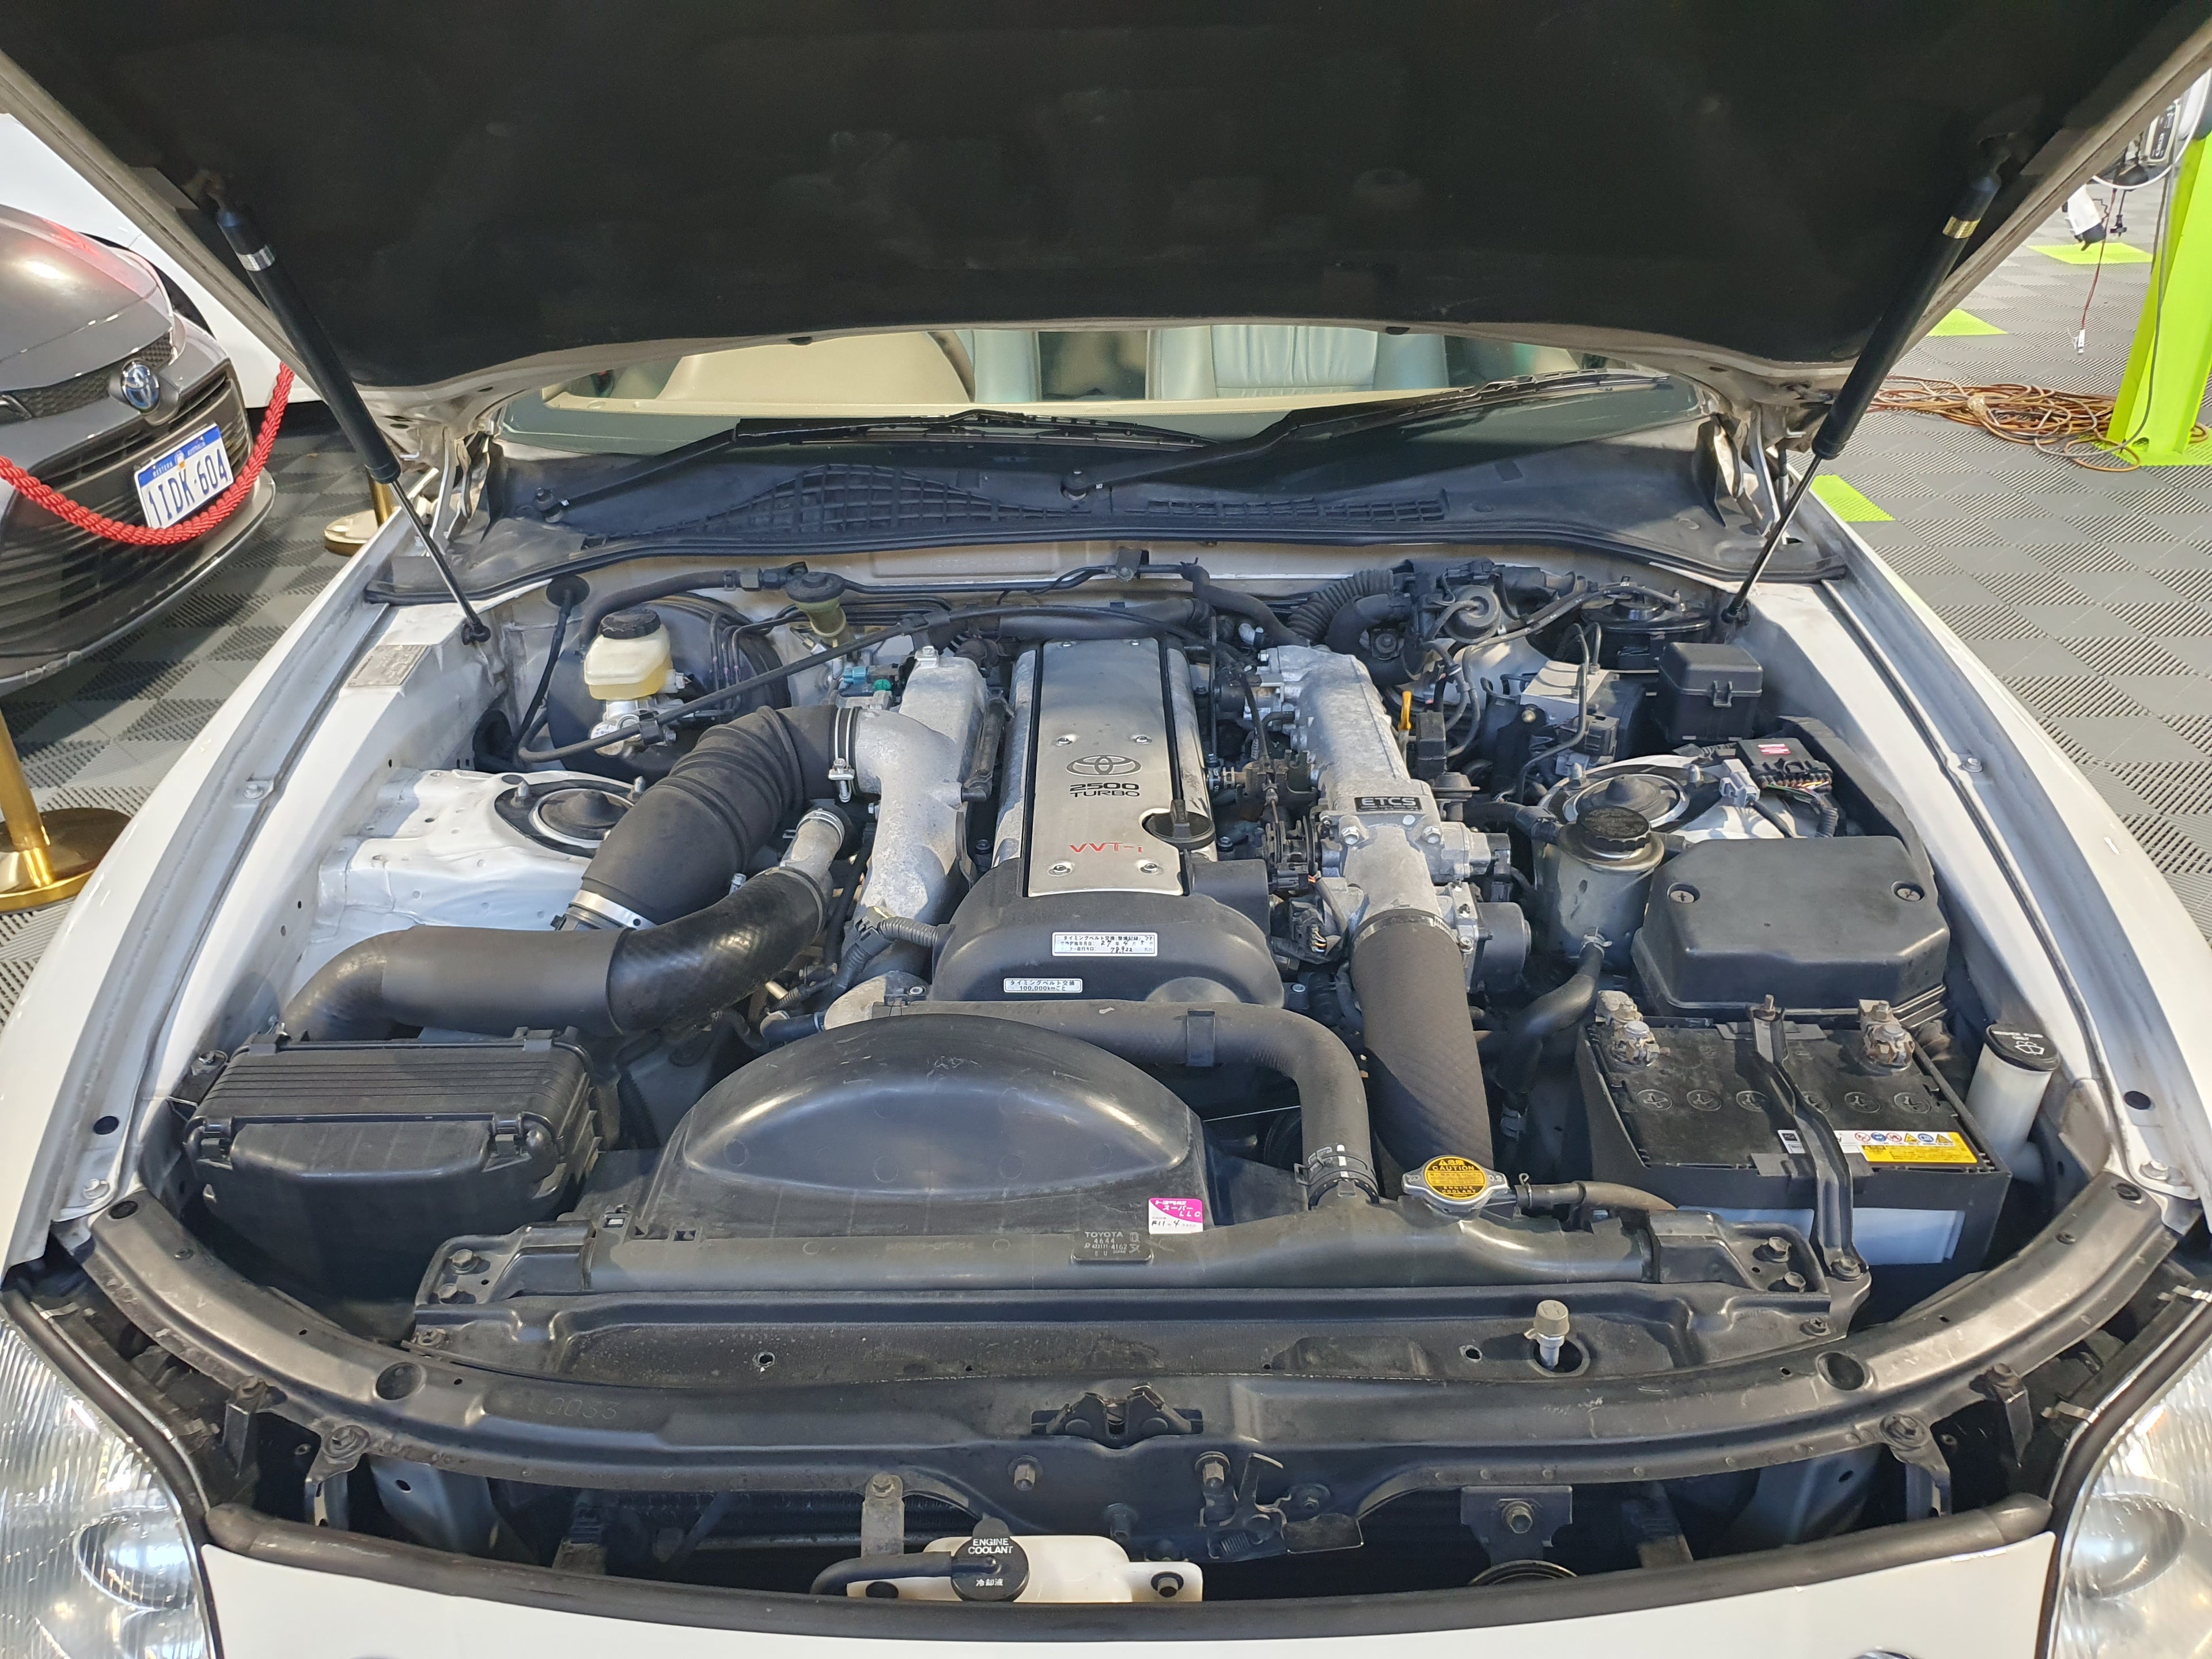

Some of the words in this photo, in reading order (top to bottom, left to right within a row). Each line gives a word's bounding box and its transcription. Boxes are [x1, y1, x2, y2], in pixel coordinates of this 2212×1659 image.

[1070, 782, 1139, 791] 2500
[1361, 797, 1416, 805] ETCS
[1069, 842, 1143, 853] VVT-i
[973, 1538, 1009, 1546] ENGINE
[968, 1546, 1013, 1554] COOLANT
